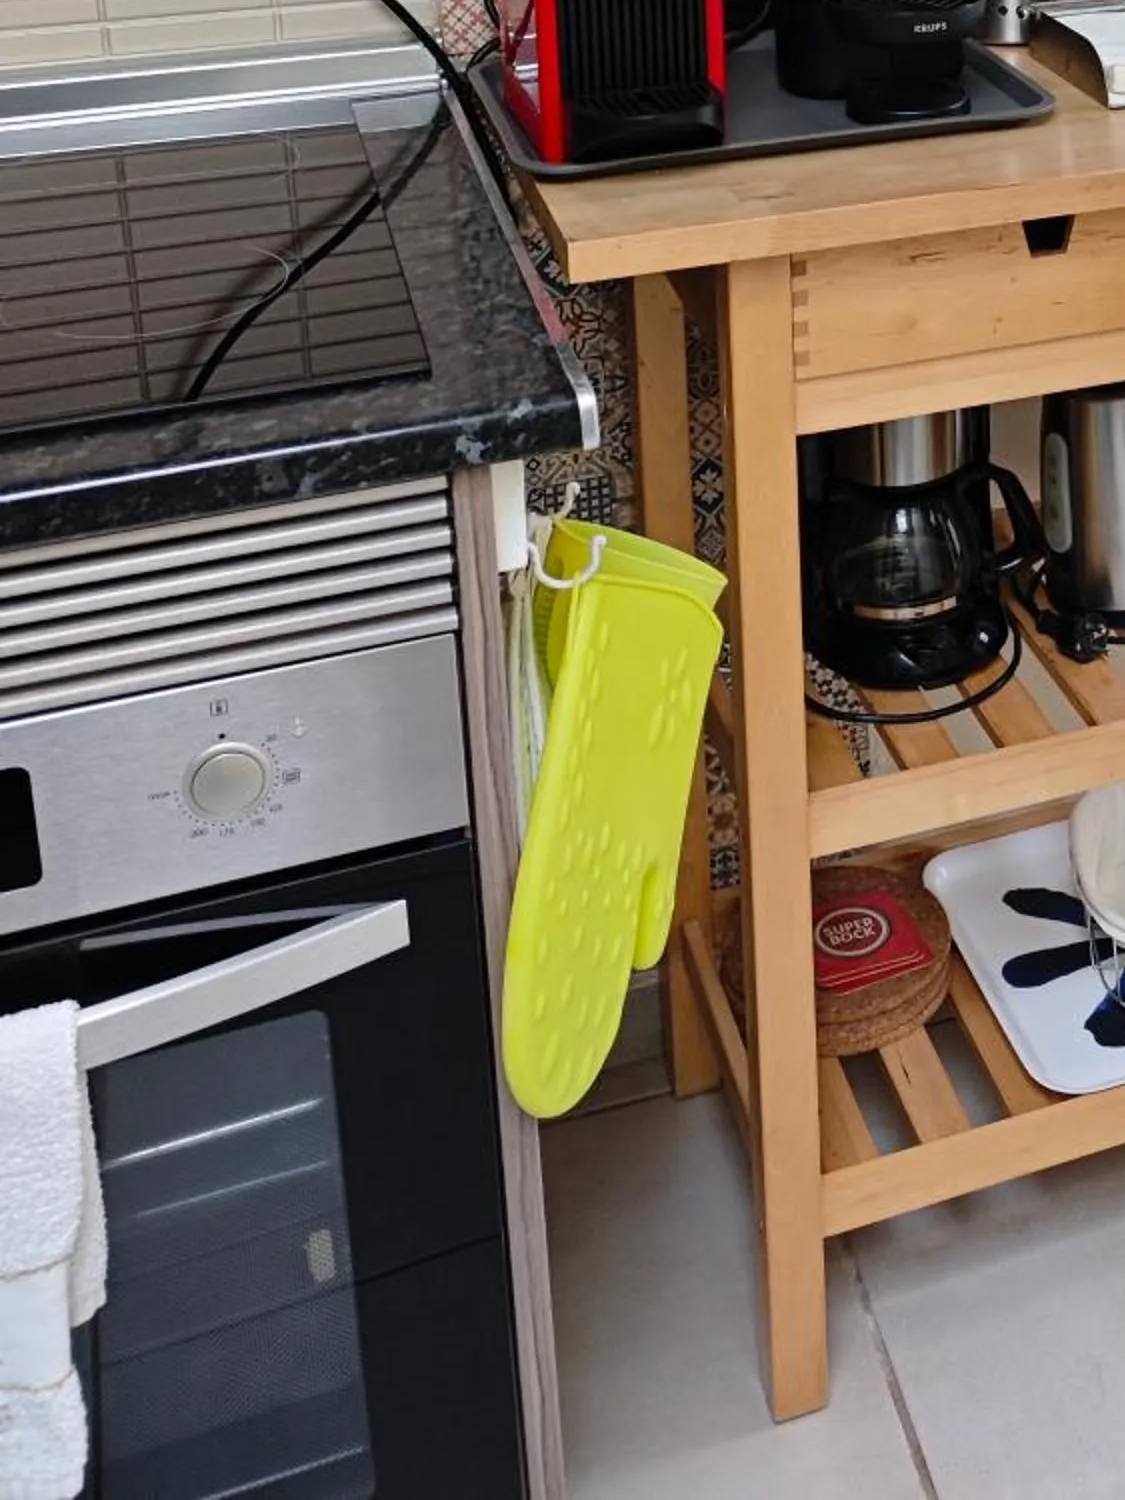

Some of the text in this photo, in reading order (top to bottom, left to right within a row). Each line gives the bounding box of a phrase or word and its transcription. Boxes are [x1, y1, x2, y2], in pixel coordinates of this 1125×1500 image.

[914, 21, 947, 33] KRUPS
[822, 916, 875, 938] SUPER
[829, 927, 877, 946] BOCK
